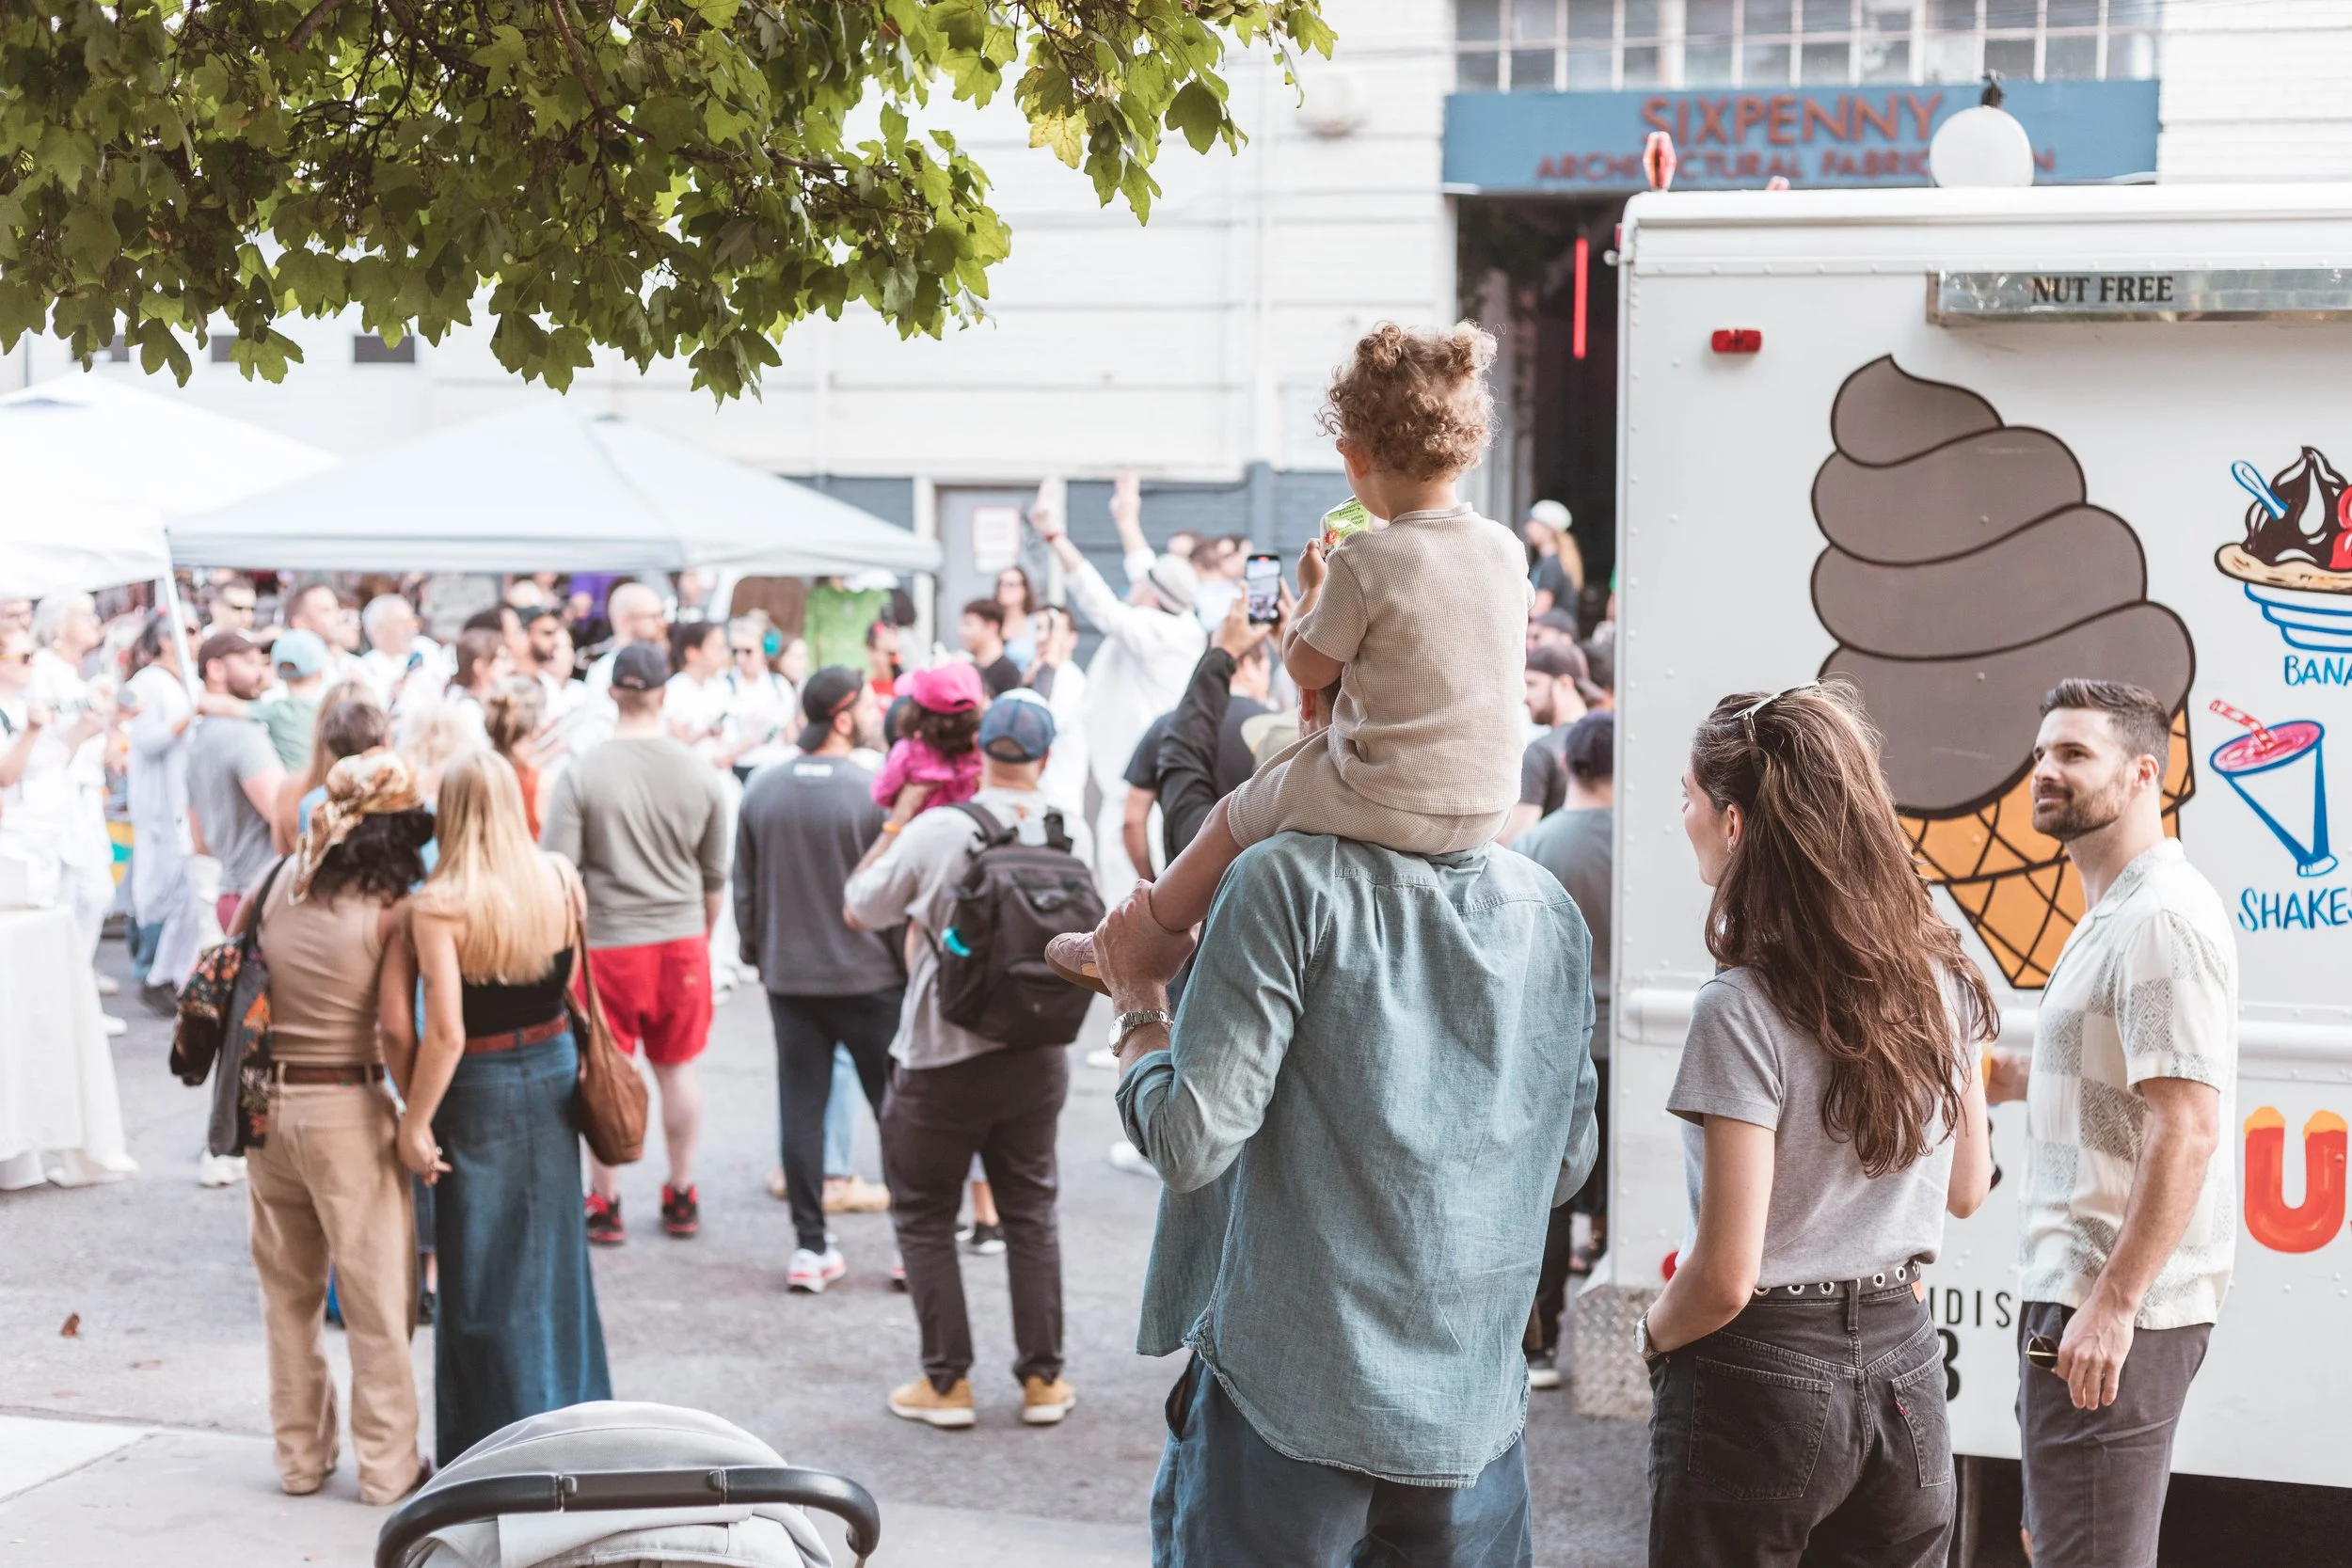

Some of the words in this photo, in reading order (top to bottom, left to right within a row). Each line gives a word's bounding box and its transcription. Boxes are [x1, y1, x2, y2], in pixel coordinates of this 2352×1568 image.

[1641, 91, 1943, 146] SIXPENNY
[1536, 151, 1803, 180] ARCHICTURAL
[2031, 276, 2090, 303] NUT
[2099, 276, 2173, 302] FREE
[2238, 887, 2352, 931] SHAKE
[2243, 1105, 2352, 1254] U
